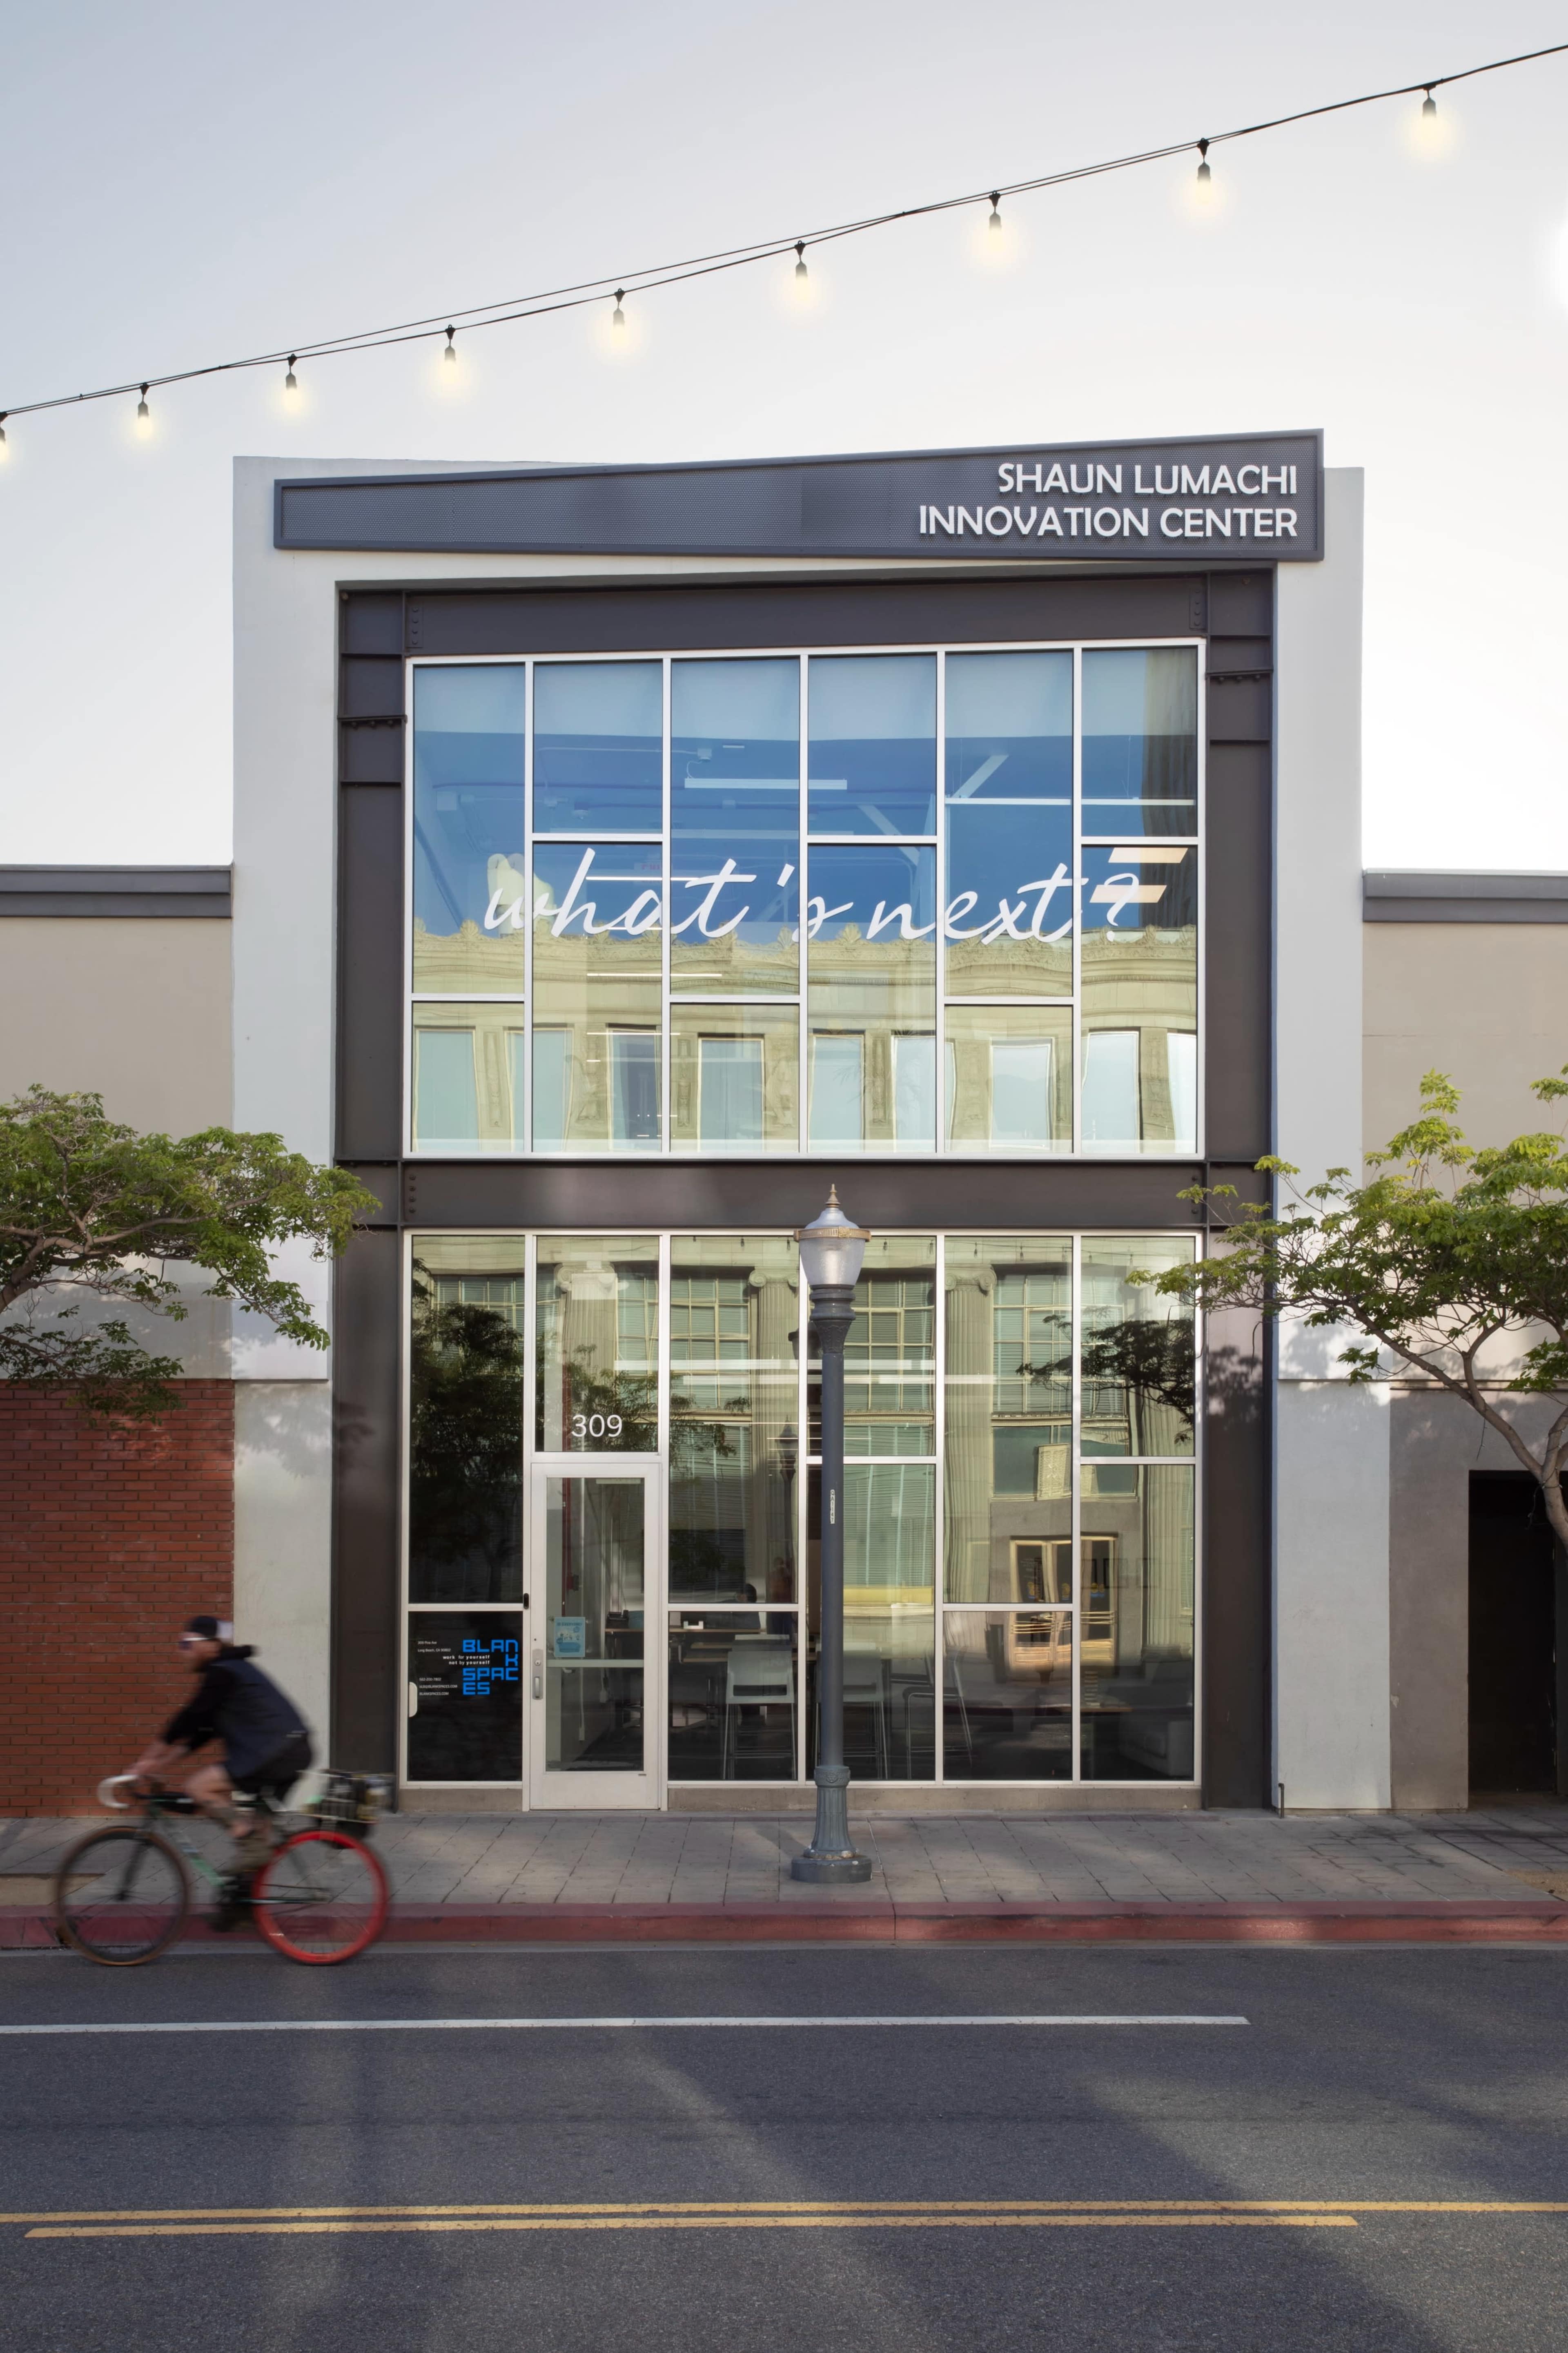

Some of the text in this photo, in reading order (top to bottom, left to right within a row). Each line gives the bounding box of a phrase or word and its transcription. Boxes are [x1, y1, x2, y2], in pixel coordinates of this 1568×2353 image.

[998, 463, 1297, 495] SHAUN LUMACHI
[920, 505, 1298, 538] INNOVATION CENTER
[484, 847, 1140, 945] what's next?
[571, 1414, 622, 1437] 309
[462, 1639, 519, 1653] BLAN
[462, 1667, 519, 1681] SPAC
[462, 1681, 490, 1695] ES
